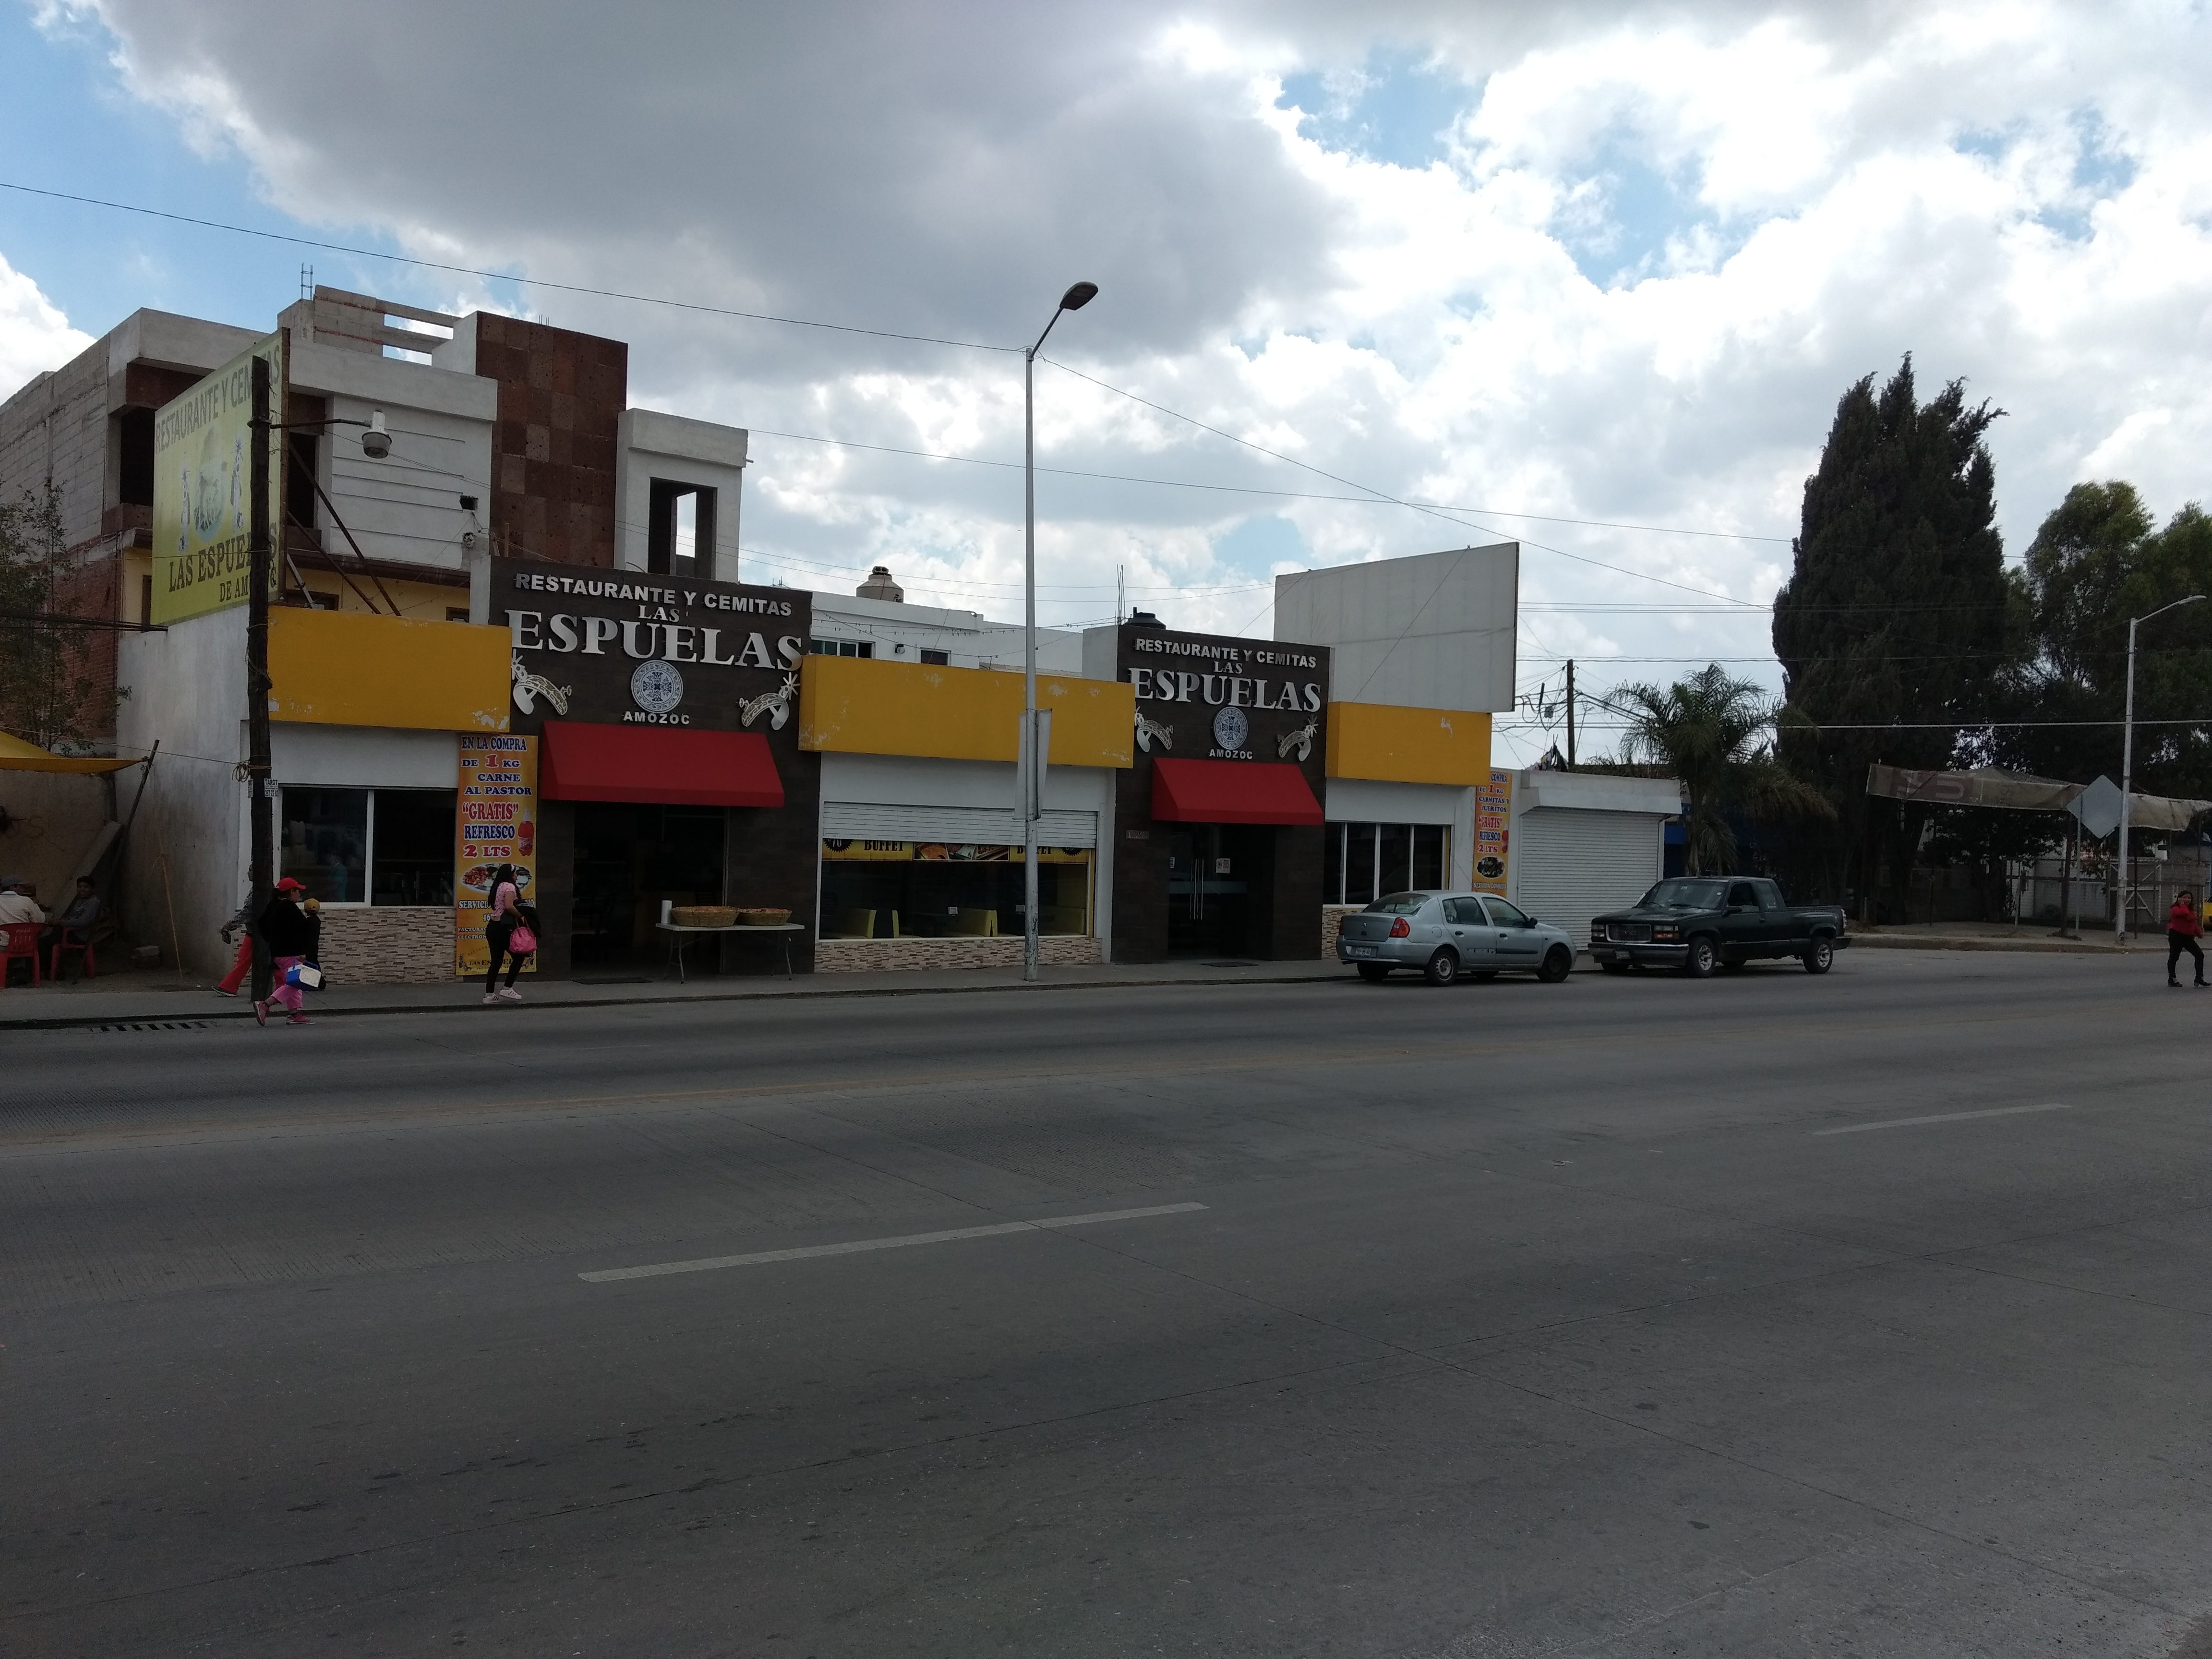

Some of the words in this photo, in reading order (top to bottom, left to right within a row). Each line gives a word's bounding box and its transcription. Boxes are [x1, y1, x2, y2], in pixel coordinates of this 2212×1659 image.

[156, 383, 219, 455] RESTAURANTE
[222, 376, 228, 413] Y
[169, 554, 193, 592] LAS
[219, 580, 232, 602] DE
[515, 573, 675, 604] RESTAURANTE
[684, 590, 697, 606] Y
[704, 593, 792, 617] CEMITAS
[638, 604, 680, 623] LAS
[504, 609, 803, 672] ESPUELAS
[1135, 637, 1238, 661] RESTAURANTE
[1243, 649, 1253, 661] Y
[1256, 650, 1317, 669] CEMITAS
[1214, 661, 1243, 674] LAS
[1128, 667, 1321, 713] ESPUELAS
[623, 711, 690, 725] AMOZOC
[462, 736, 474, 749] EN
[476, 737, 489, 750] LA
[491, 737, 527, 751] COMPRA
[1209, 748, 1253, 759] AMOZOC
[485, 754, 498, 768] 1
[477, 773, 521, 782] CARNE
[1491, 773, 1507, 782] COMPRA
[464, 786, 482, 795] AL
[484, 786, 532, 796] PASTOR
[1489, 785, 1494, 793] 1
[464, 825, 515, 839] REFRESCO
[1479, 831, 1501, 841] REFRESCO
[464, 845, 478, 857] 2
[482, 846, 511, 857] LTS
[1479, 844, 1484, 852] 2
